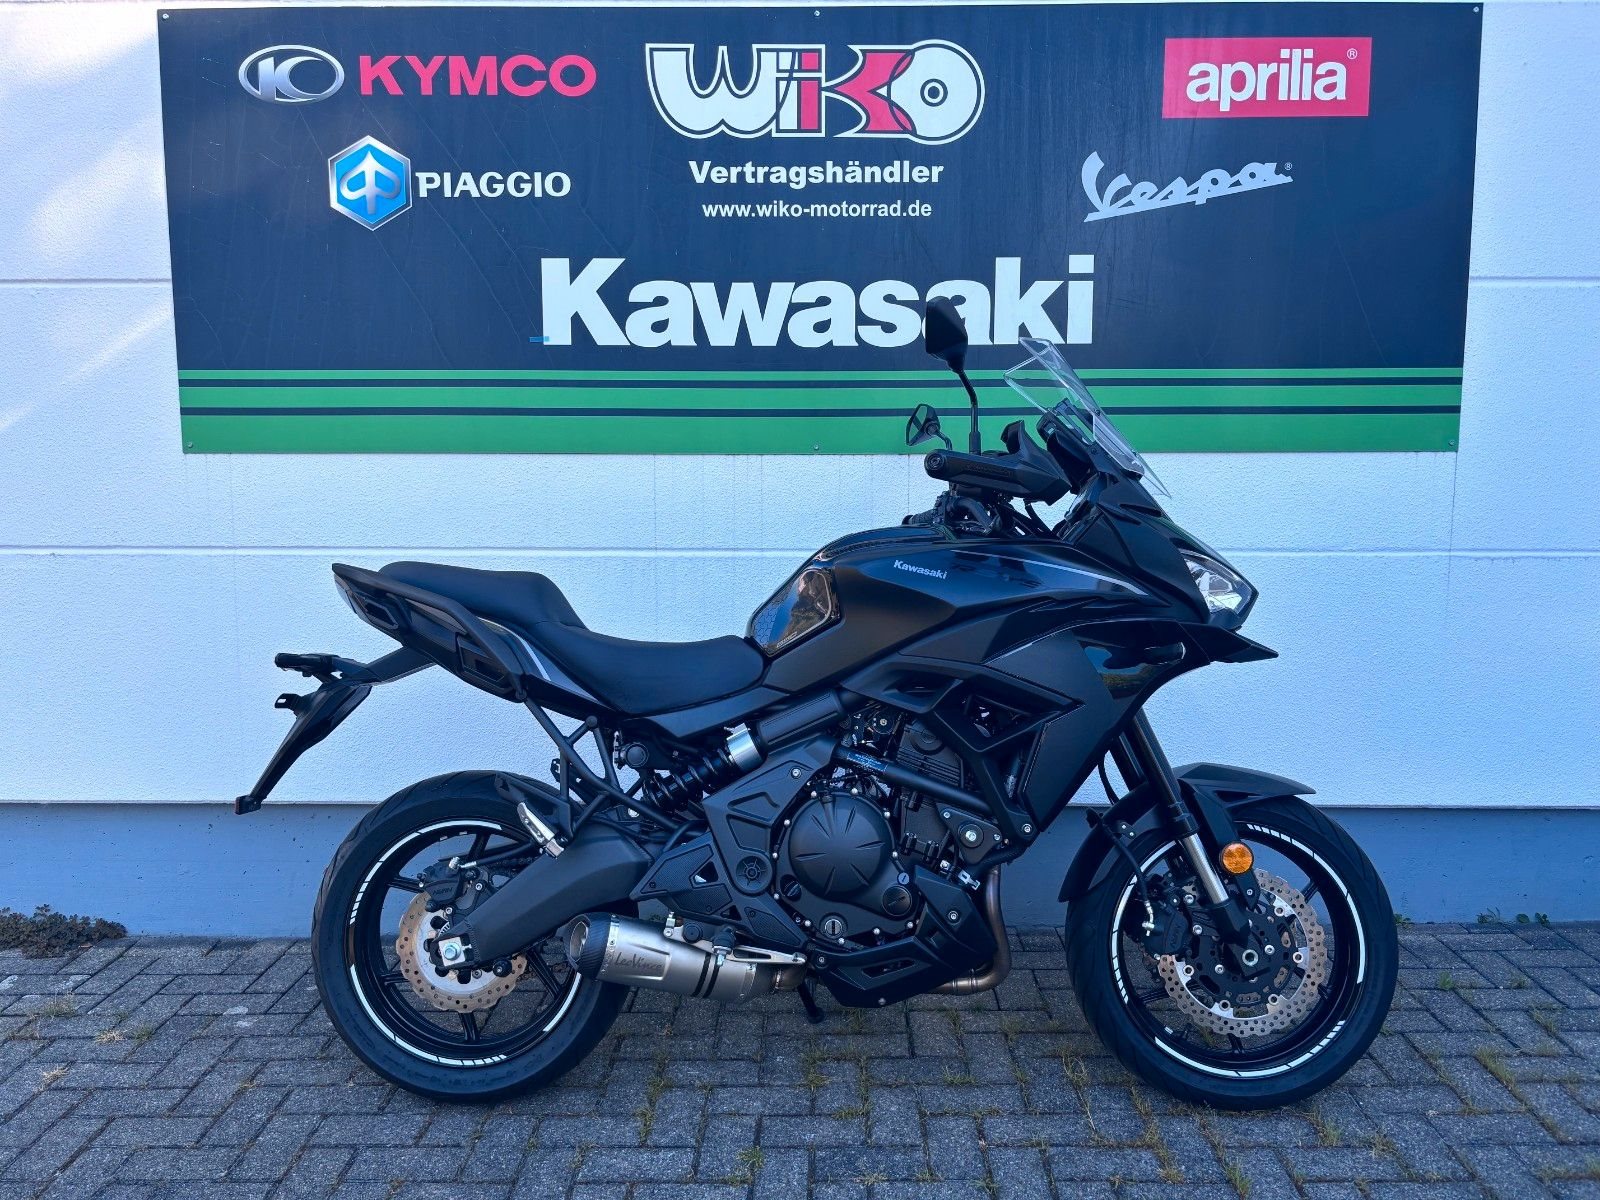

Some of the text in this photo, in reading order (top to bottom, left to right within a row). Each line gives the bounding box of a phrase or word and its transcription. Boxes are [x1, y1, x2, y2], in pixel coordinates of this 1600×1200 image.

[359, 54, 597, 97] KYMCO
[415, 171, 572, 198] PIAGGIO
[688, 160, 945, 189] Vertragshändler
[702, 200, 933, 217] www.wiko-motorrad.de
[541, 254, 1095, 347] Kawasaki
[893, 559, 948, 579] Kawasaki
